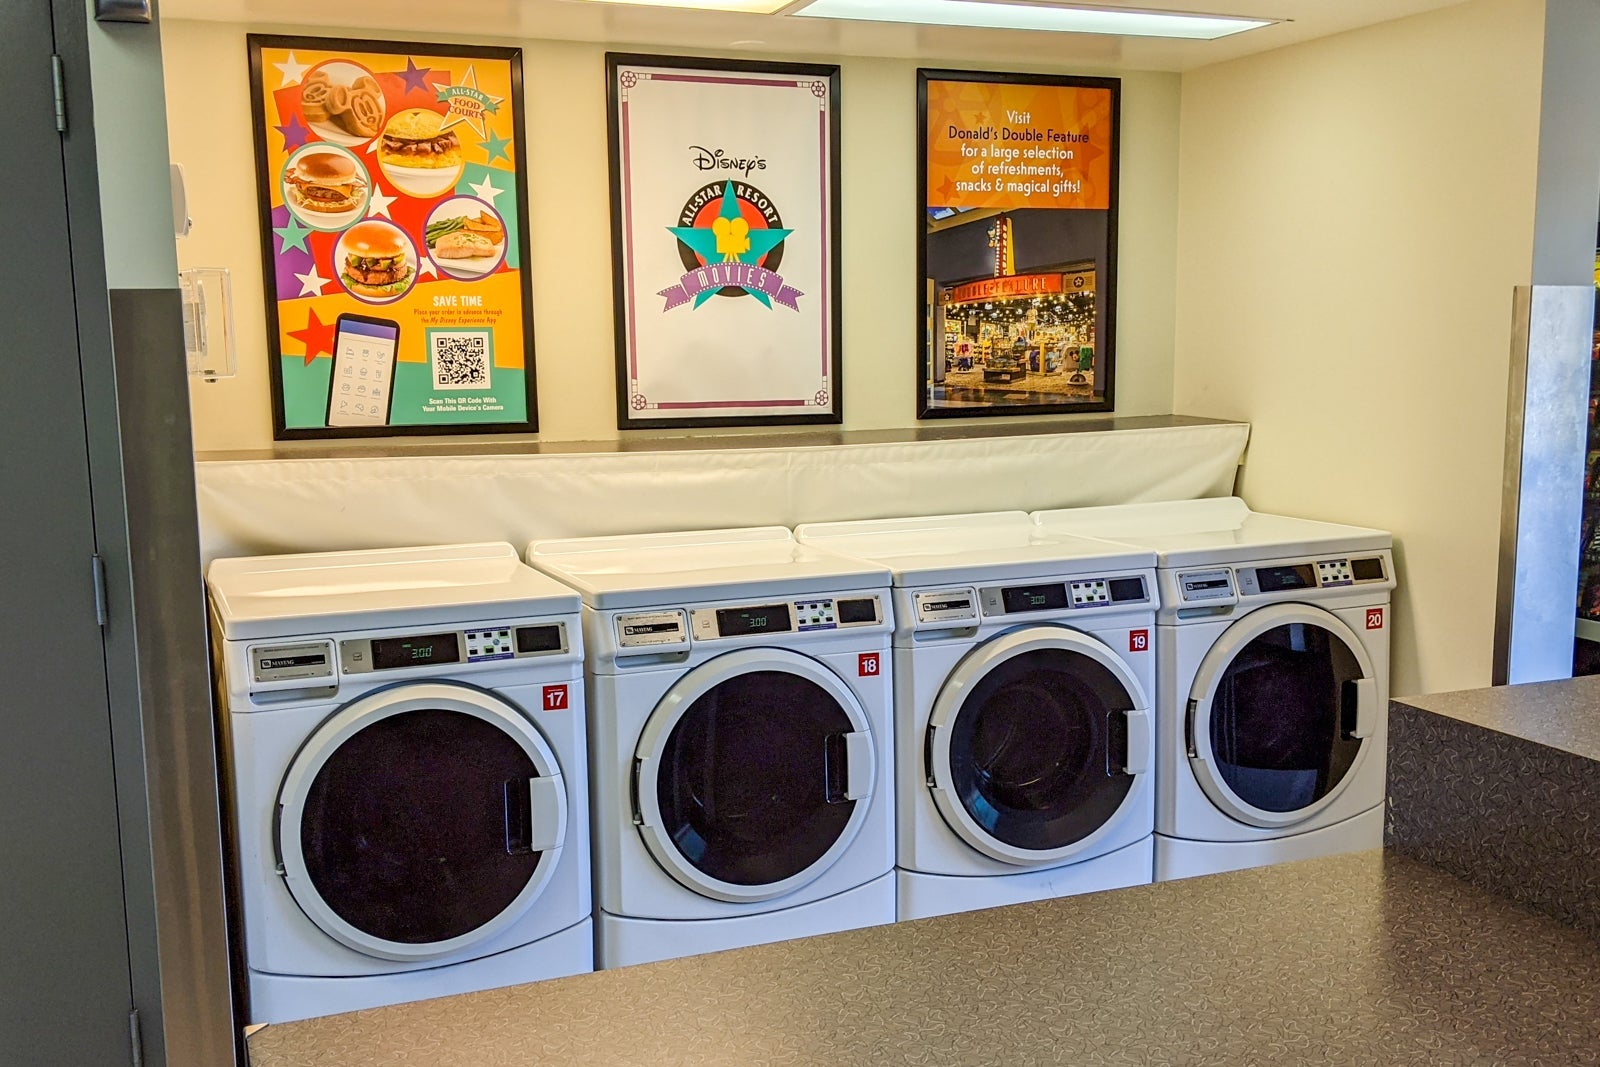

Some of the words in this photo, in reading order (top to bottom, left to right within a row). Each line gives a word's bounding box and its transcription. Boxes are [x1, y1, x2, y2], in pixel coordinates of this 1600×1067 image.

[452, 88, 484, 101] ALL-STAR
[454, 98, 480, 110] FOOD
[449, 106, 486, 121] COURTS
[1006, 110, 1031, 124] Visit
[949, 125, 998, 140] Donald's
[1002, 127, 1043, 141] Double
[1047, 129, 1089, 143] Feature
[961, 143, 978, 157] for
[981, 147, 987, 157] a
[991, 144, 1019, 162] large
[1023, 145, 1073, 160] selection
[688, 145, 767, 178] Disney's
[971, 161, 985, 174] of
[988, 162, 1064, 178] refreshments,
[956, 180, 992, 192] snacks
[995, 178, 1003, 191] &
[1007, 179, 1050, 196] magical
[1052, 179, 1080, 197] gifts!
[681, 184, 723, 226] ALL-STAR
[736, 184, 778, 223] RESORT
[697, 266, 767, 287] MOVIES
[433, 295, 458, 307] SAVE
[460, 295, 483, 307] TIME
[1368, 614, 1382, 627] 20
[1132, 635, 1146, 649] 19
[861, 659, 877, 673] 18
[547, 691, 564, 707] 17
